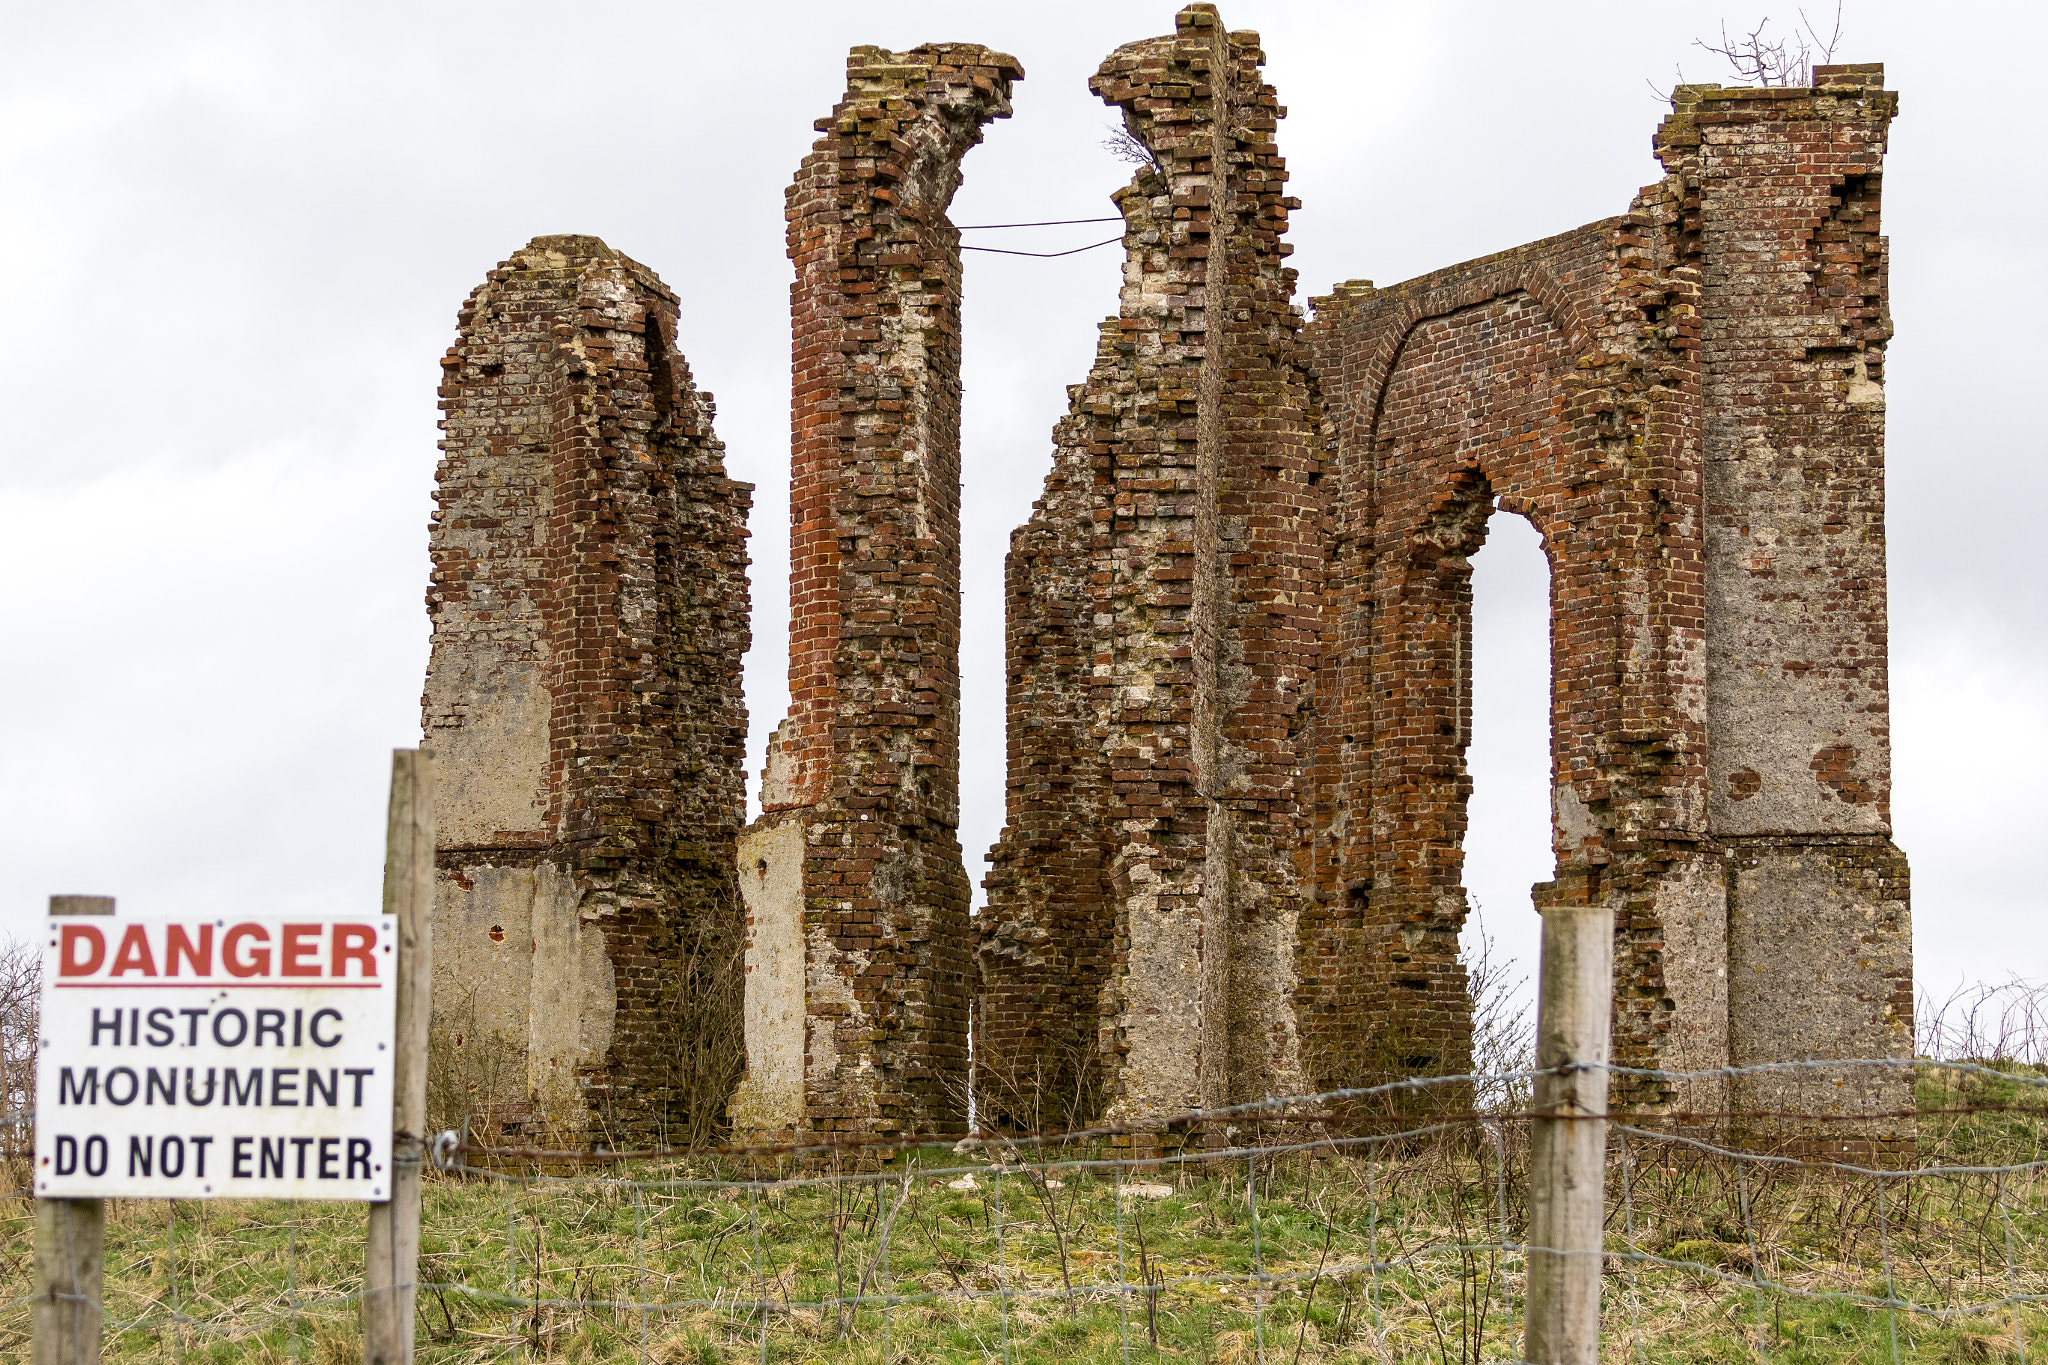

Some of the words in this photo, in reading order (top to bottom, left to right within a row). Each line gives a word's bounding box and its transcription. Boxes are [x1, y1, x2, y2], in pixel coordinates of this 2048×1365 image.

[58, 922, 378, 978] DANGER
[90, 1007, 343, 1048] HISTORIC
[58, 1066, 374, 1107] MONUMENT
[54, 1134, 108, 1177] DO
[128, 1135, 213, 1178] NOT
[231, 1136, 373, 1180] ENTER
